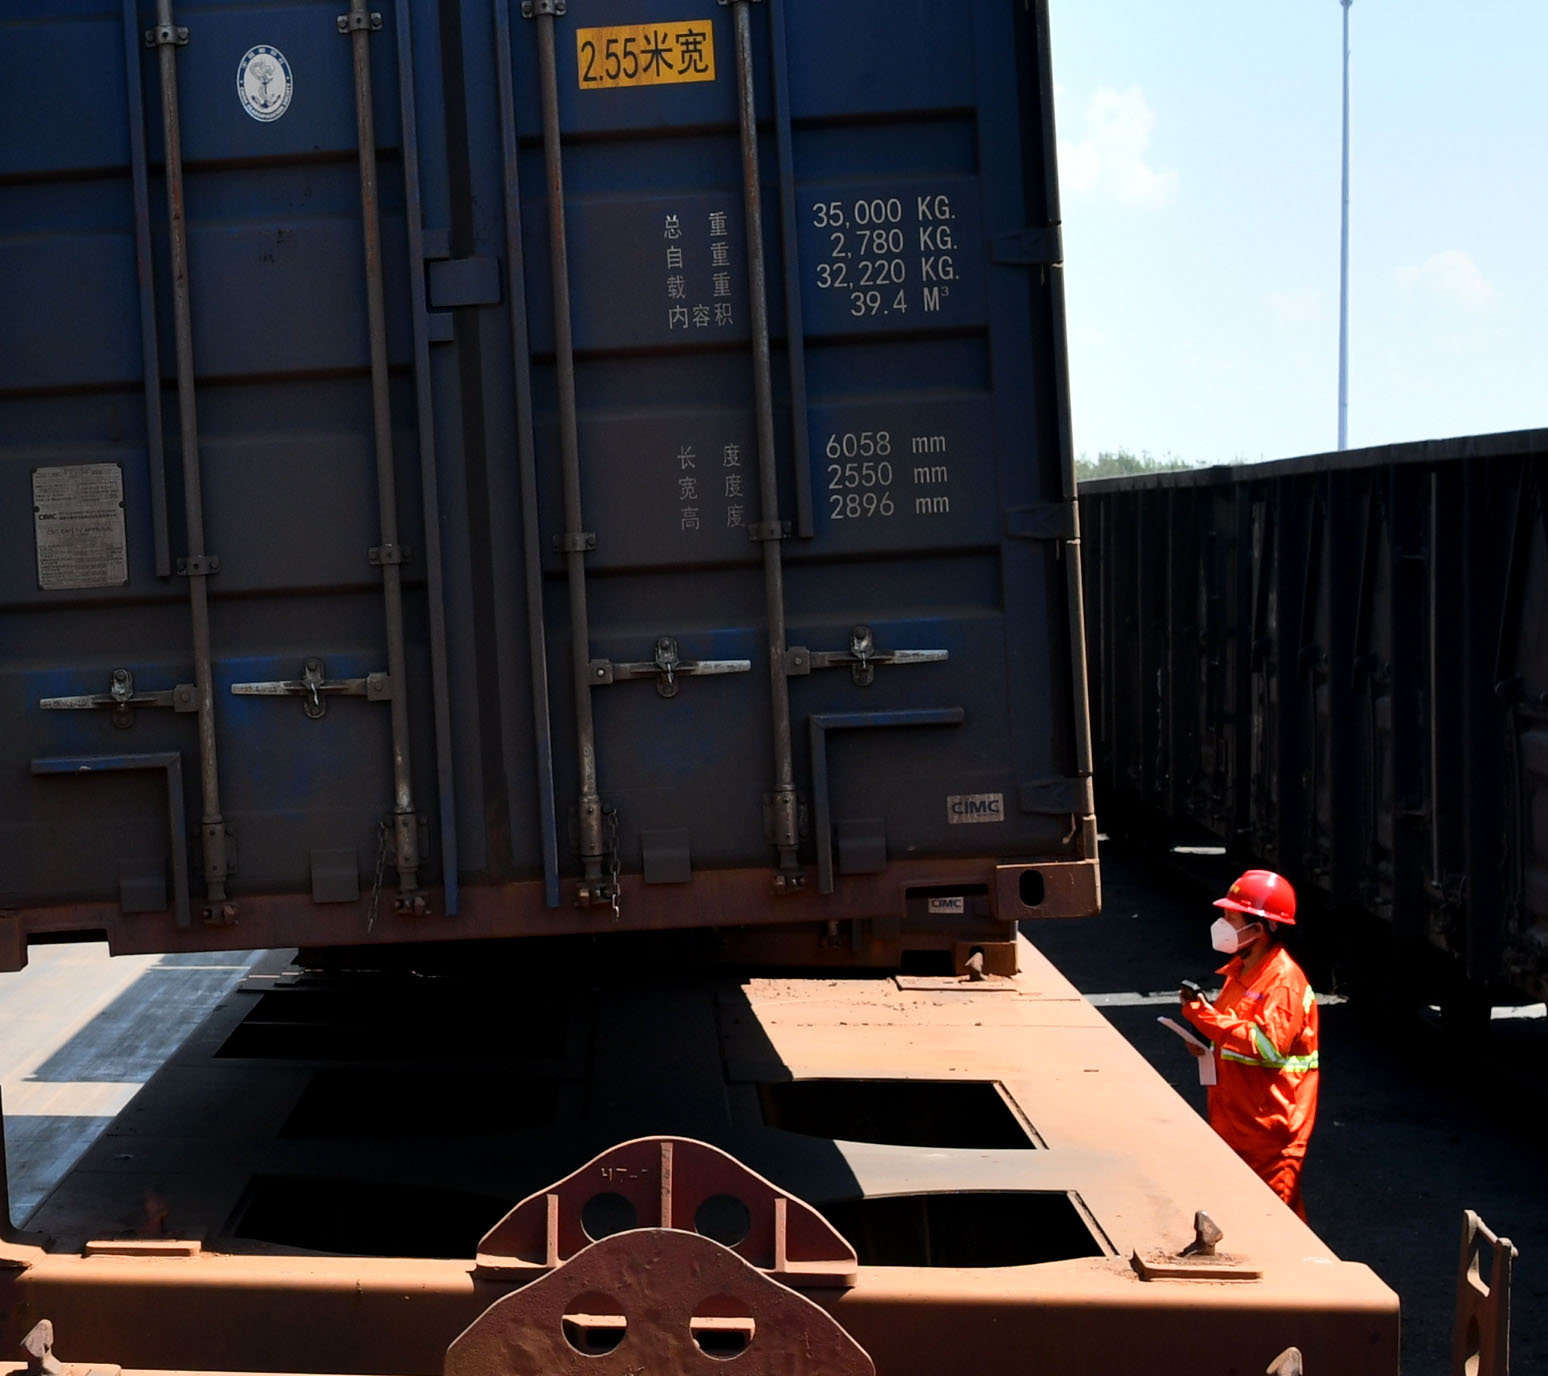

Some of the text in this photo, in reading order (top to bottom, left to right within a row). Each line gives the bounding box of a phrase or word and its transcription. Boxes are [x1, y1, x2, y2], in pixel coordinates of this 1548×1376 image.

[580, 29, 709, 83] 2.55米宽
[664, 195, 955, 240] 总 重 35,000 KG.
[666, 225, 957, 270] 自 重 2,780 KG.
[667, 255, 959, 300] 载 重 32,220 KG.
[668, 303, 734, 329] 内容积
[850, 290, 907, 317] 39.4
[677, 431, 946, 470] 长 度 6058 mm
[678, 461, 948, 501] 宽 度 2550 mm
[680, 505, 701, 531] 高
[829, 492, 895, 520] 2896
[915, 495, 950, 515] mm
[952, 800, 1000, 814] CIMC
[931, 899, 961, 908] CIMC
